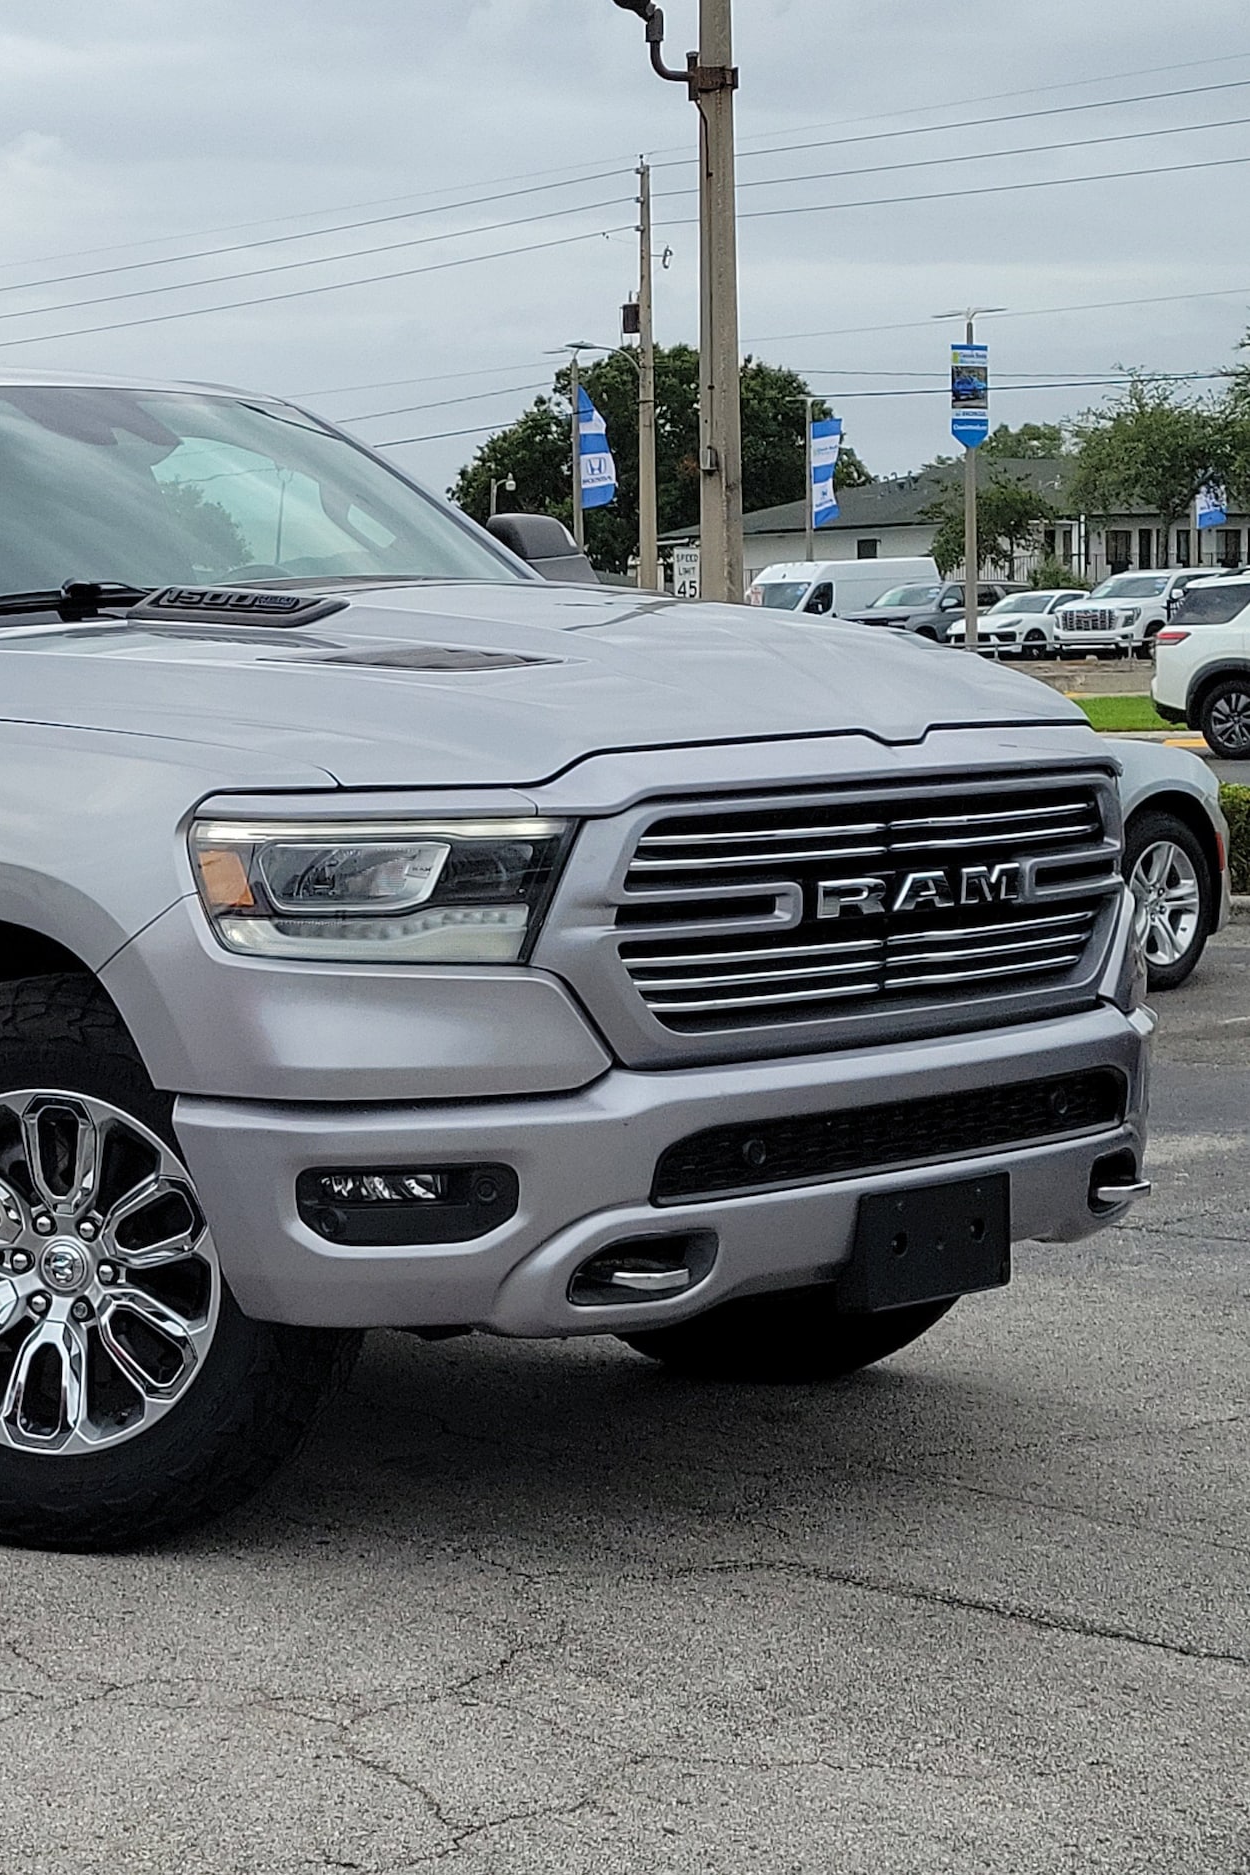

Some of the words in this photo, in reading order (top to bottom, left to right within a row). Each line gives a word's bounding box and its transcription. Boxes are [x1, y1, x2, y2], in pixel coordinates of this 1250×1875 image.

[676, 553, 699, 563] SPEED
[159, 588, 256, 608] 1500
[677, 580, 698, 598] 45
[816, 861, 1020, 919] RAM
